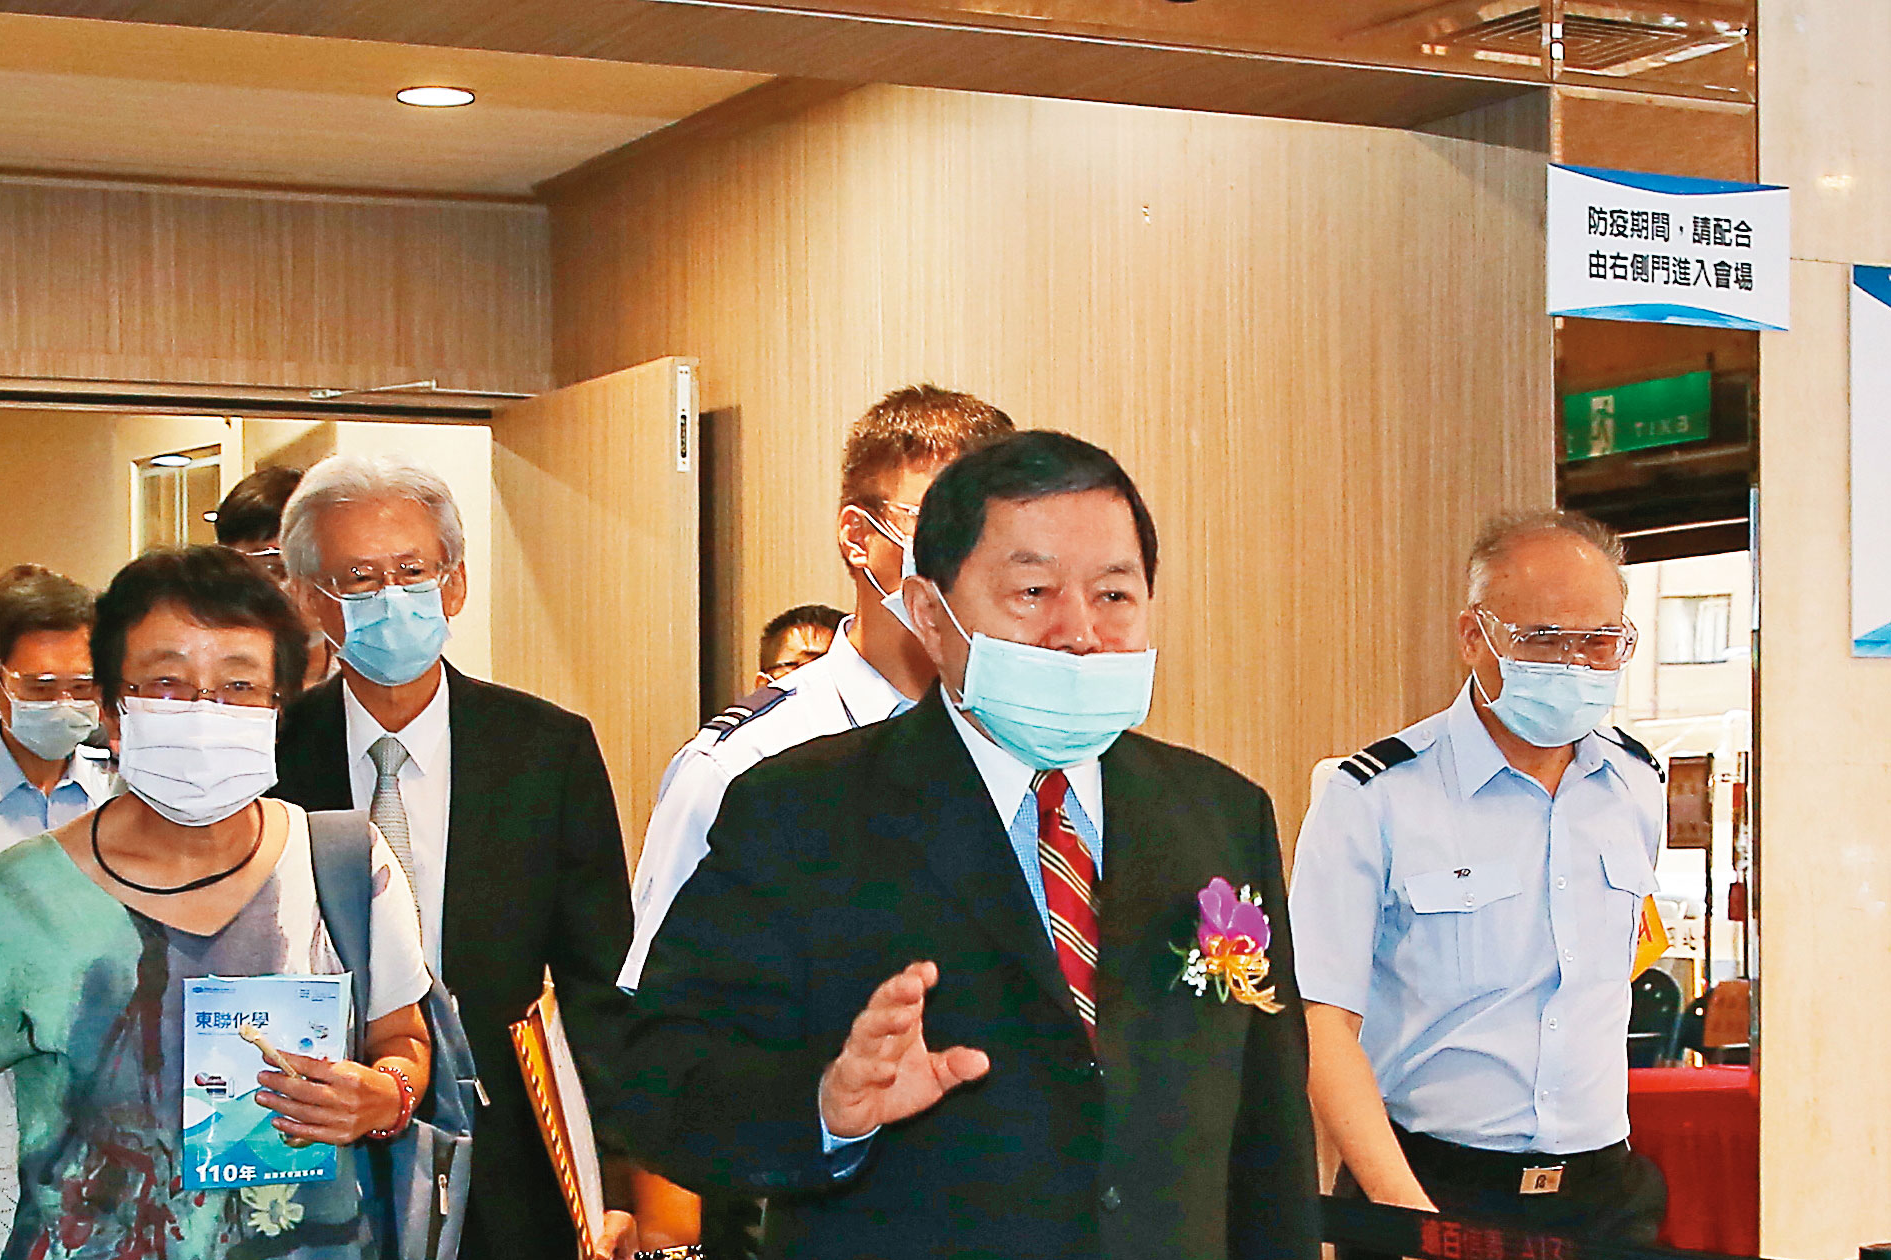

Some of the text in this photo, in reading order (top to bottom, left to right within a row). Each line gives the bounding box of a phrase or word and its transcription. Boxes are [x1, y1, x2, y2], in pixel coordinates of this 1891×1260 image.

[1588, 205, 1753, 249] 防疫期間，請配合
[1588, 249, 1754, 291] 由右側門進入會場
[194, 1011, 269, 1029] 東聯化學
[195, 1164, 257, 1183] 110年
